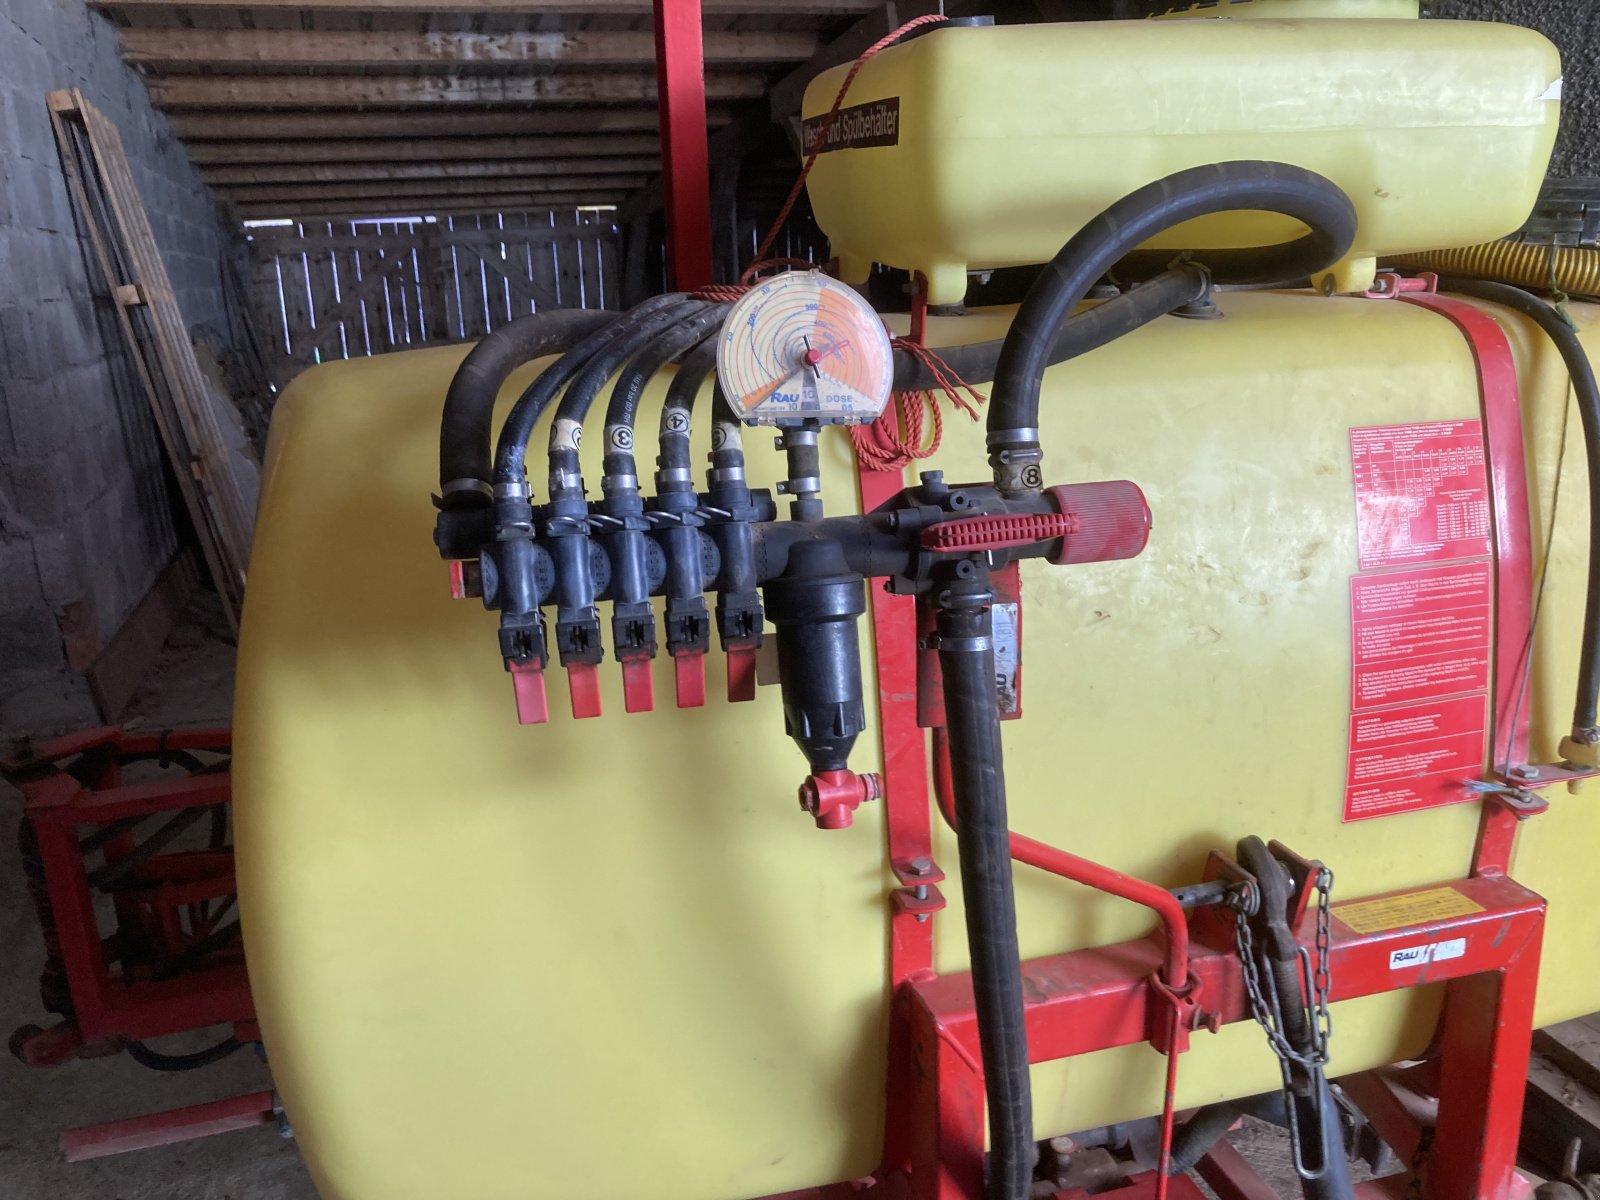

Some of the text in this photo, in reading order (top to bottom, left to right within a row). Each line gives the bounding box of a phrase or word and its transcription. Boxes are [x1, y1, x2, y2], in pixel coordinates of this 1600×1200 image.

[827, 115, 841, 144] und
[842, 105, 898, 145] Spülbehälter
[770, 392, 800, 403] RAU
[826, 394, 853, 403] DOSE
[670, 415, 684, 429] 4
[617, 431, 630, 446] 3
[1027, 468, 1039, 485] 8
[1392, 951, 1419, 963] RAU
